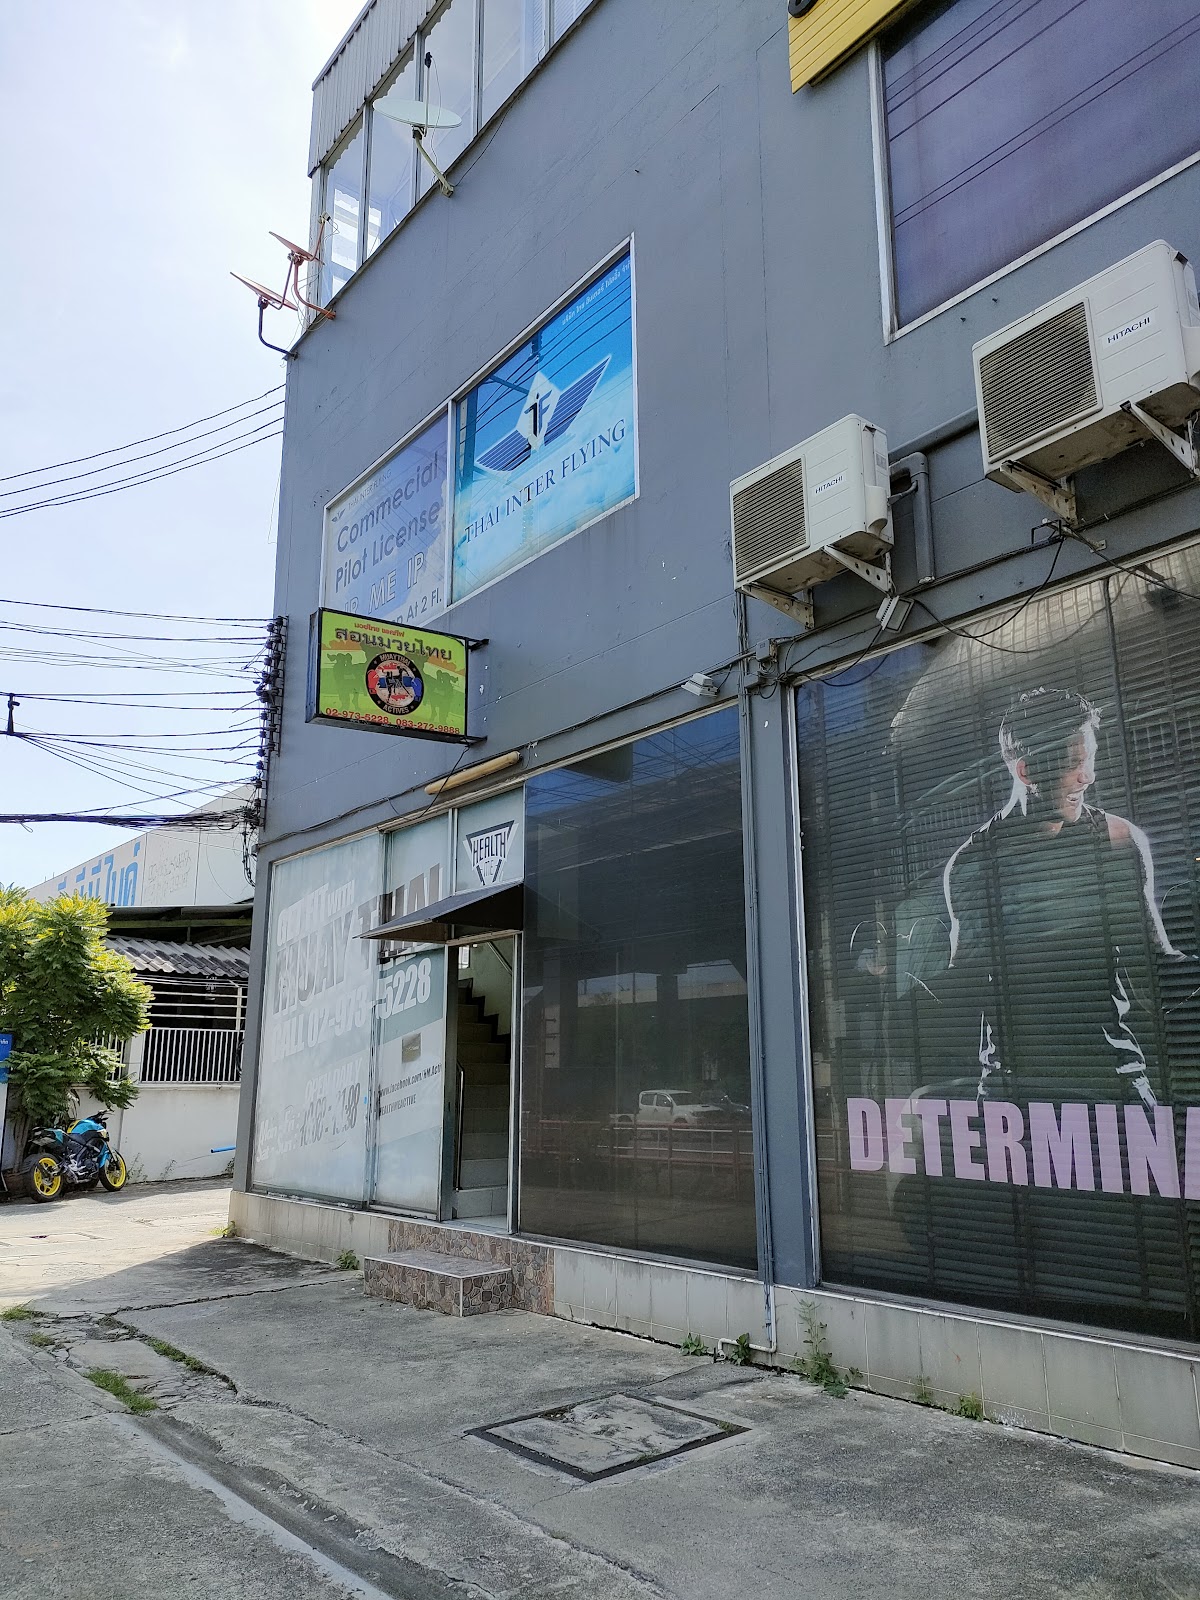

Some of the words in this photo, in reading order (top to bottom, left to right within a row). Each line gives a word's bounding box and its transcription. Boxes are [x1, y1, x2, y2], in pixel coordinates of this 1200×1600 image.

[1107, 317, 1150, 344] HITACHI
[465, 506, 499, 543] THAI
[506, 469, 556, 517] INTER
[561, 419, 625, 480] FLYING
[815, 475, 843, 494] HITACHI
[338, 450, 438, 553] Commecial
[335, 548, 368, 593] Pilot
[373, 501, 440, 567] License
[368, 569, 396, 615] ME
[407, 551, 424, 590] IP
[406, 602, 418, 622] At
[421, 596, 427, 613] 2
[335, 627, 452, 660] สอนมวยไทย
[382, 704, 410, 714] ACTIVES
[396, 718, 460, 734] 083-272-9888
[472, 831, 506, 868] HEALTH
[272, 909, 354, 1018] MUAY
